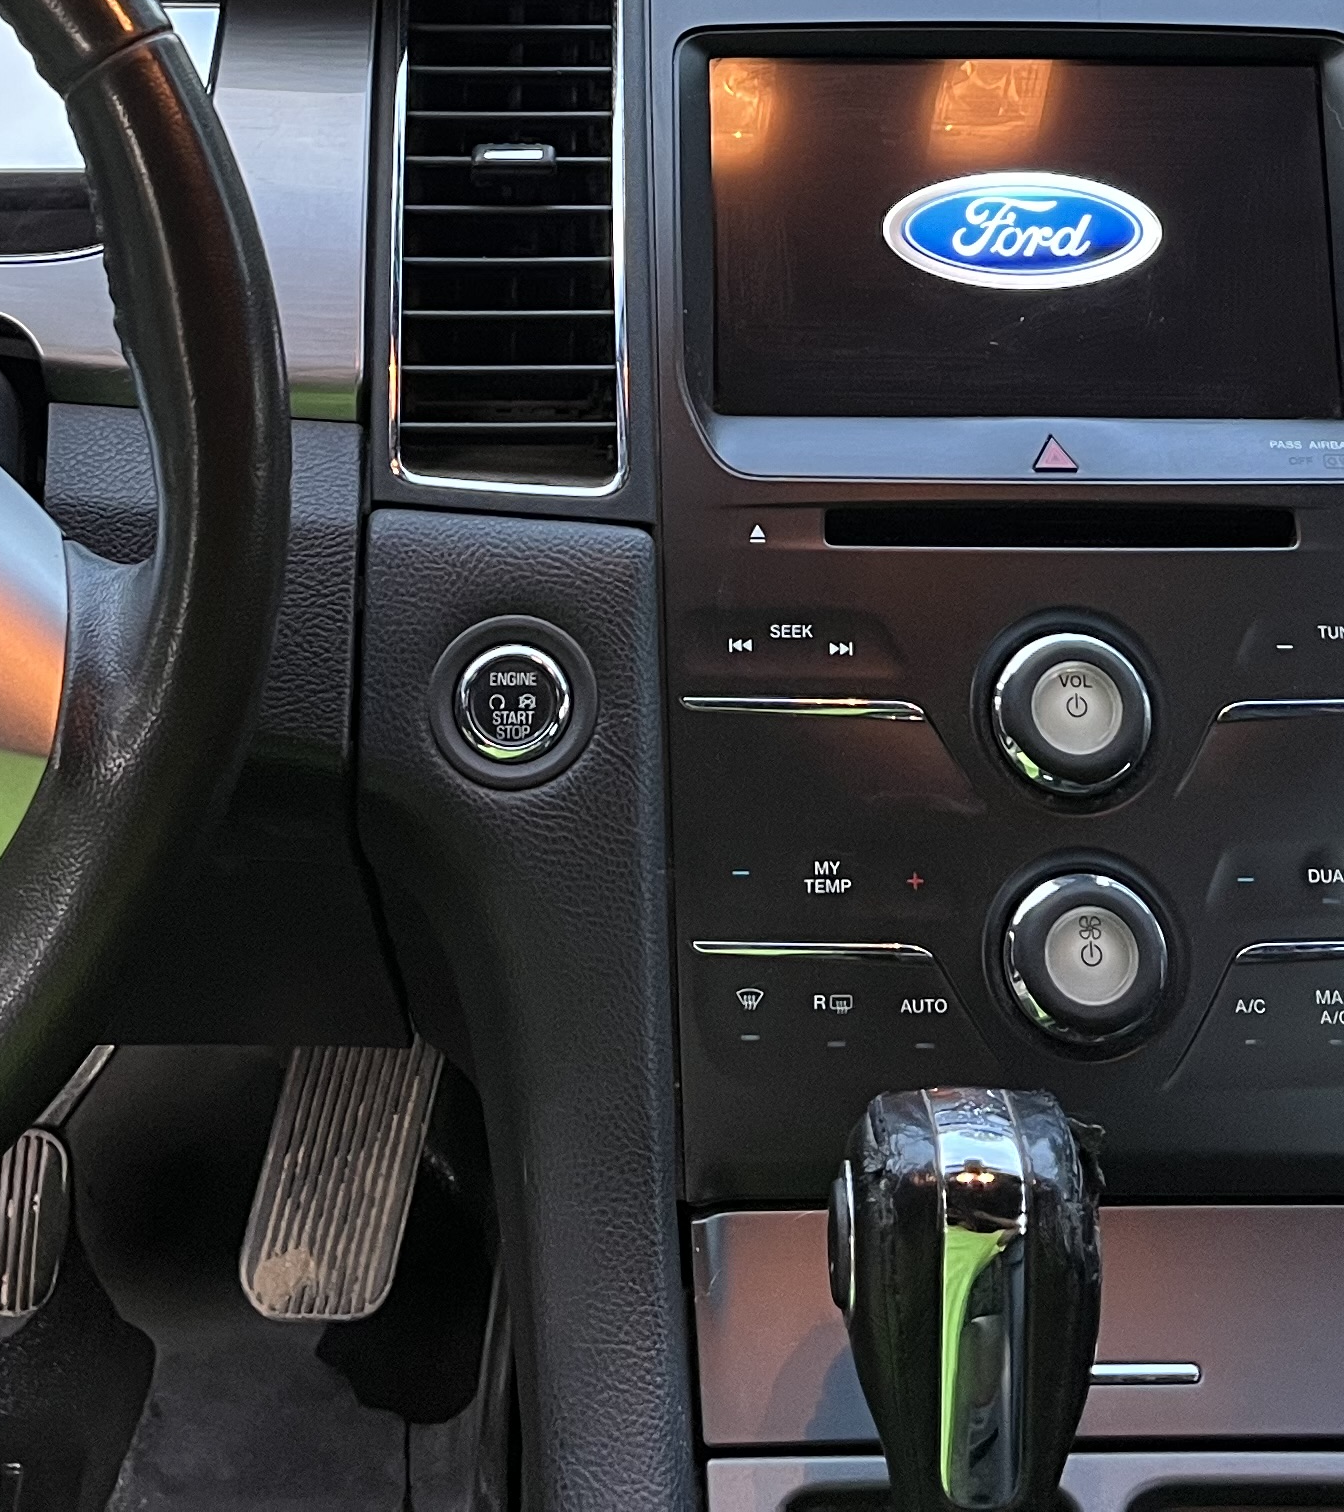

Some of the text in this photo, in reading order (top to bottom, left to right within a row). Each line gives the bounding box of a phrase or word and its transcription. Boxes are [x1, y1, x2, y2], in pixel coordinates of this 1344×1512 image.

[952, 195, 1092, 258] Ford
[1269, 440, 1303, 450] PASS
[769, 624, 813, 640] SEEK
[489, 672, 538, 687] ENGINE
[1058, 673, 1093, 690] VOL
[492, 710, 535, 726] START
[496, 724, 531, 740] STOP
[813, 861, 842, 877] MY
[803, 878, 853, 895] TEMP
[813, 995, 827, 1011] R
[900, 998, 948, 1015] AUTO
[1235, 998, 1267, 1016] A/C
